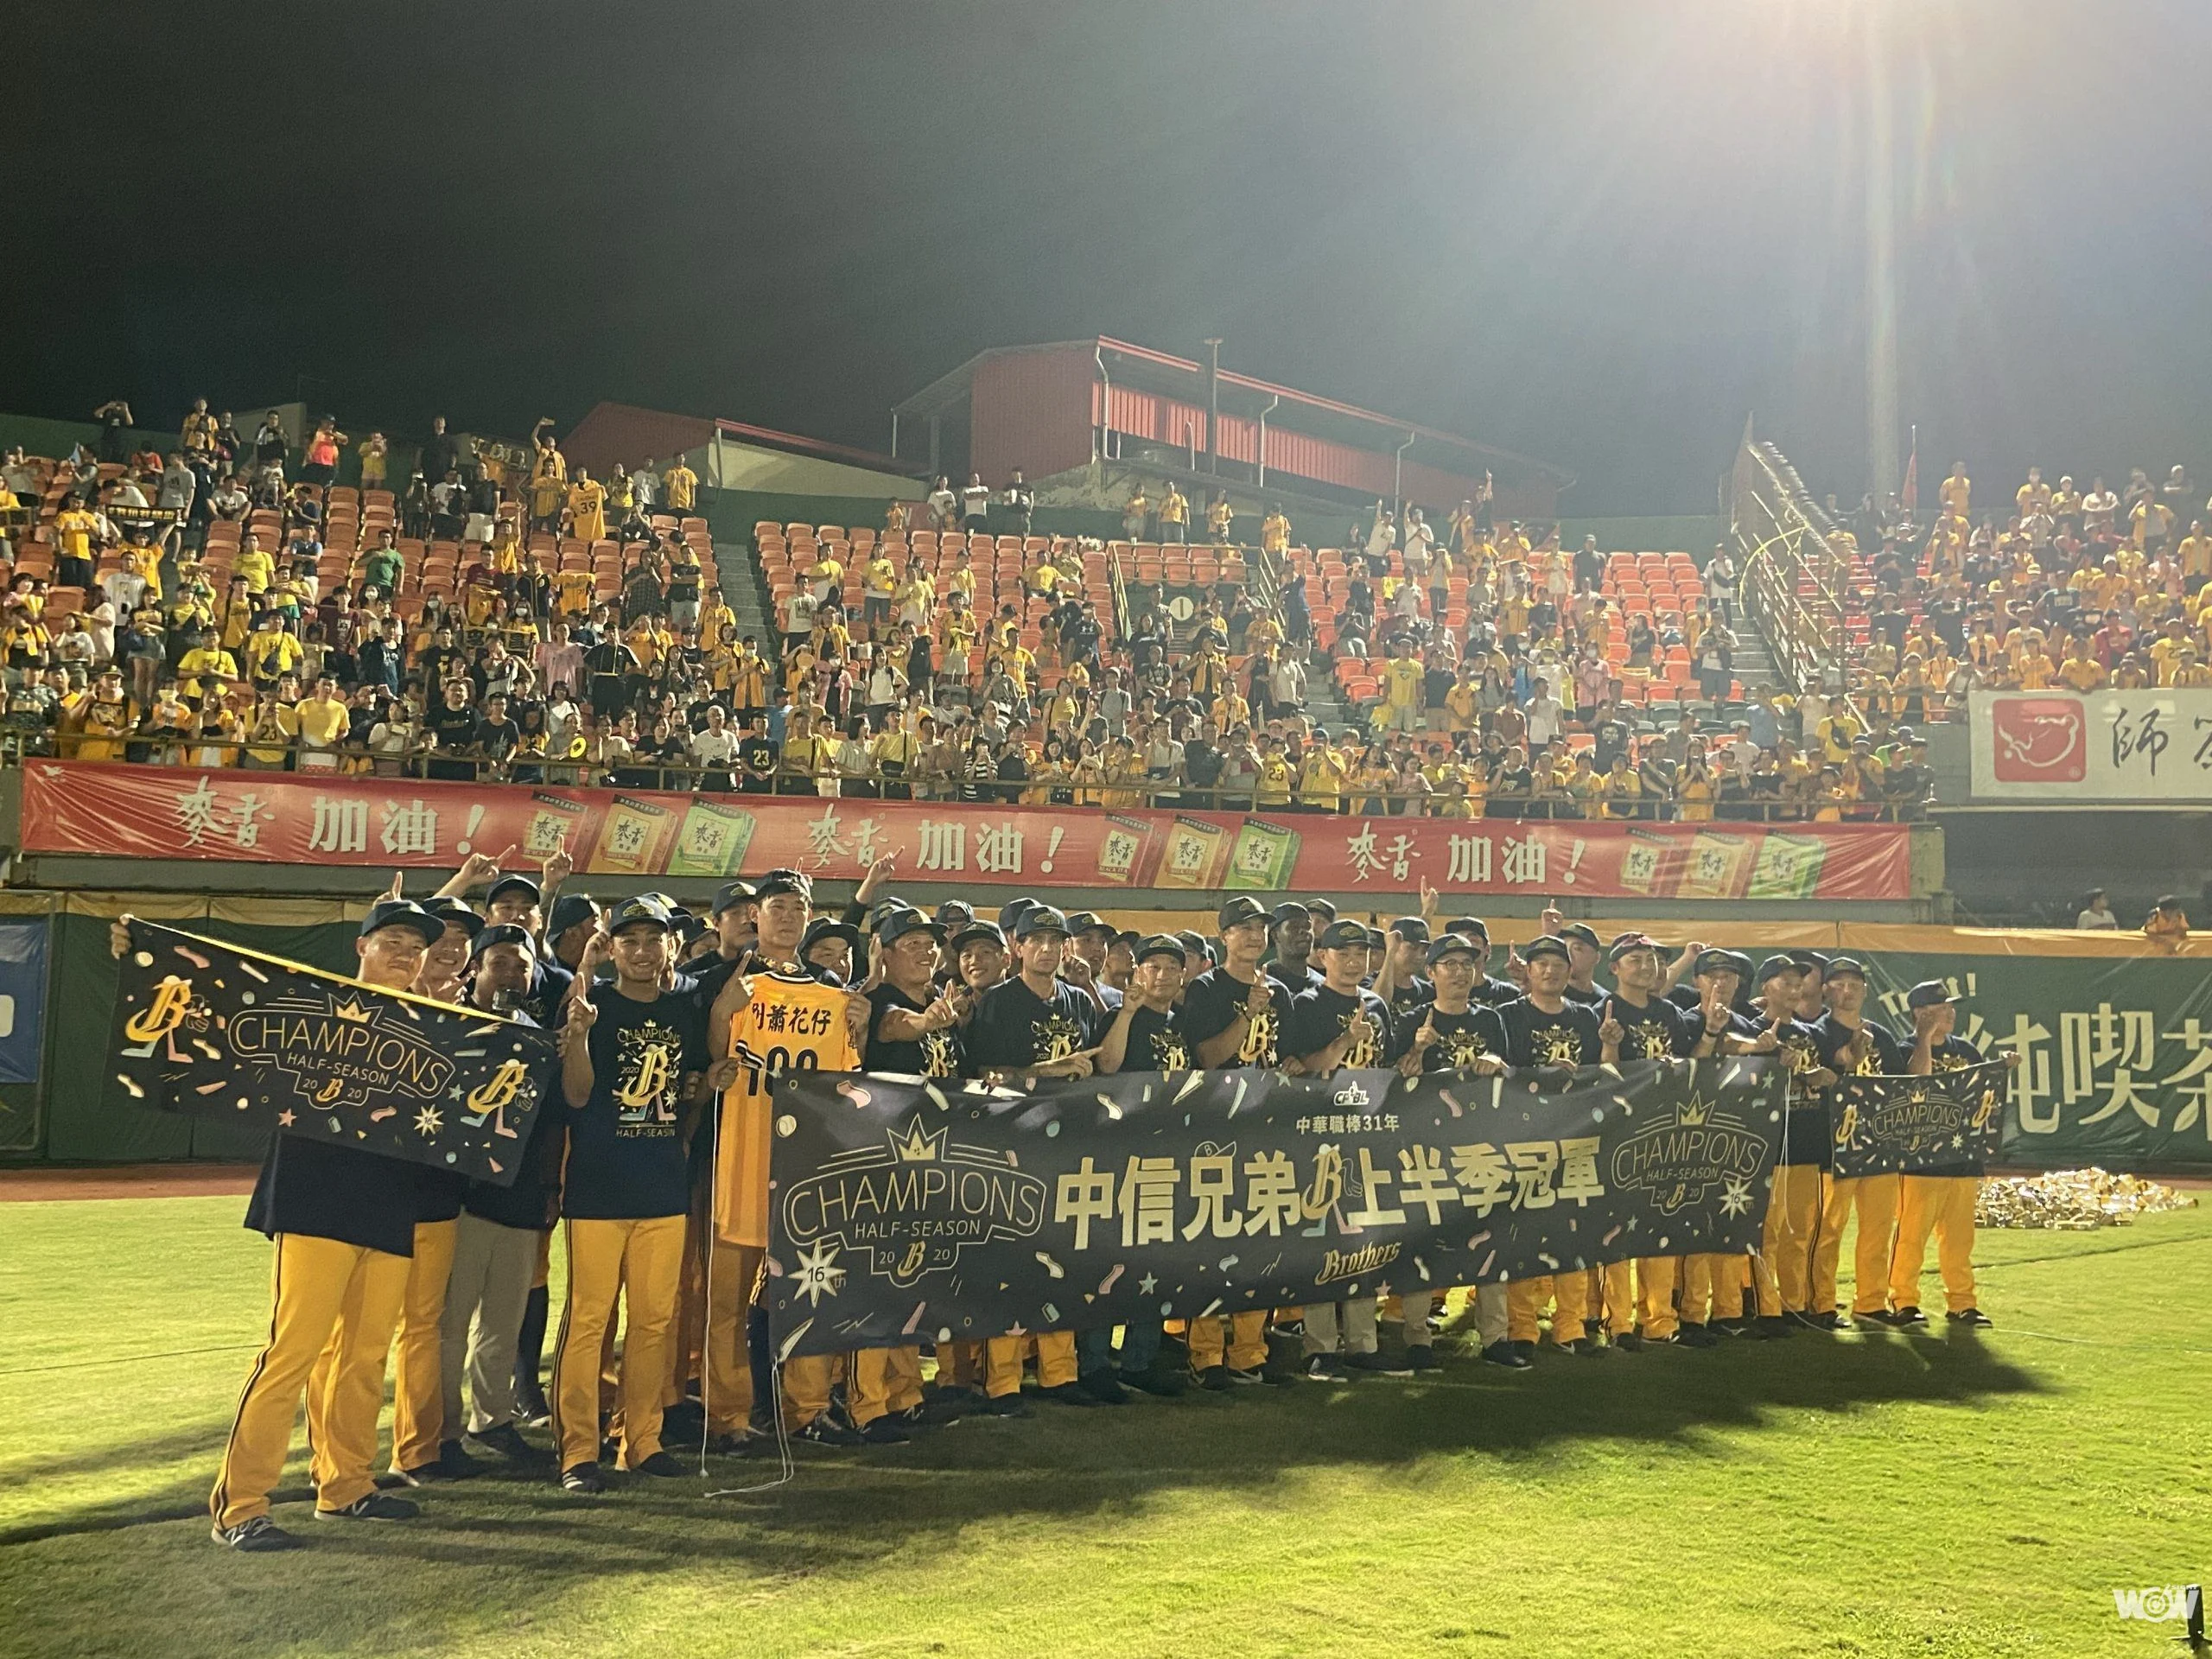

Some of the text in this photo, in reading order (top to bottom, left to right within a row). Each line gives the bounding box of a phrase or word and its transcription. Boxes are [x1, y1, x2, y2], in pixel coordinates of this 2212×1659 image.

[581, 501, 596, 514] 39
[753, 749, 770, 766] 23
[174, 775, 485, 855] 麥香 加油！
[617, 819, 645, 845] 麥香
[696, 823, 722, 847] 麥香
[809, 804, 1065, 874] 麥香 加油！
[1345, 821, 1586, 884] 麥香 加油！
[617, 1027, 681, 1043] CHAMPIONS
[234, 1017, 448, 1092] CHAMPIONS
[287, 1052, 390, 1085] HALF-SEASON
[302, 1078, 318, 1089] 20
[346, 1088, 362, 1099] 20
[1334, 1090, 1369, 1104] CPBL
[1296, 1114, 1400, 1135] 中華職棒31年
[1874, 1105, 1961, 1135] CHAMPIONS
[1617, 1130, 1762, 1182] CHAMPIONS
[1646, 1166, 1719, 1182] HALF-SEASON
[791, 1169, 1039, 1236] CHAMPIONS
[1731, 1192, 1740, 1204] 16
[855, 1219, 981, 1239] HALF-SEASON
[880, 1251, 895, 1264] 20
[933, 1249, 950, 1261] 20
[1315, 1241, 1402, 1285] Brothers
[808, 1267, 824, 1282] 16
